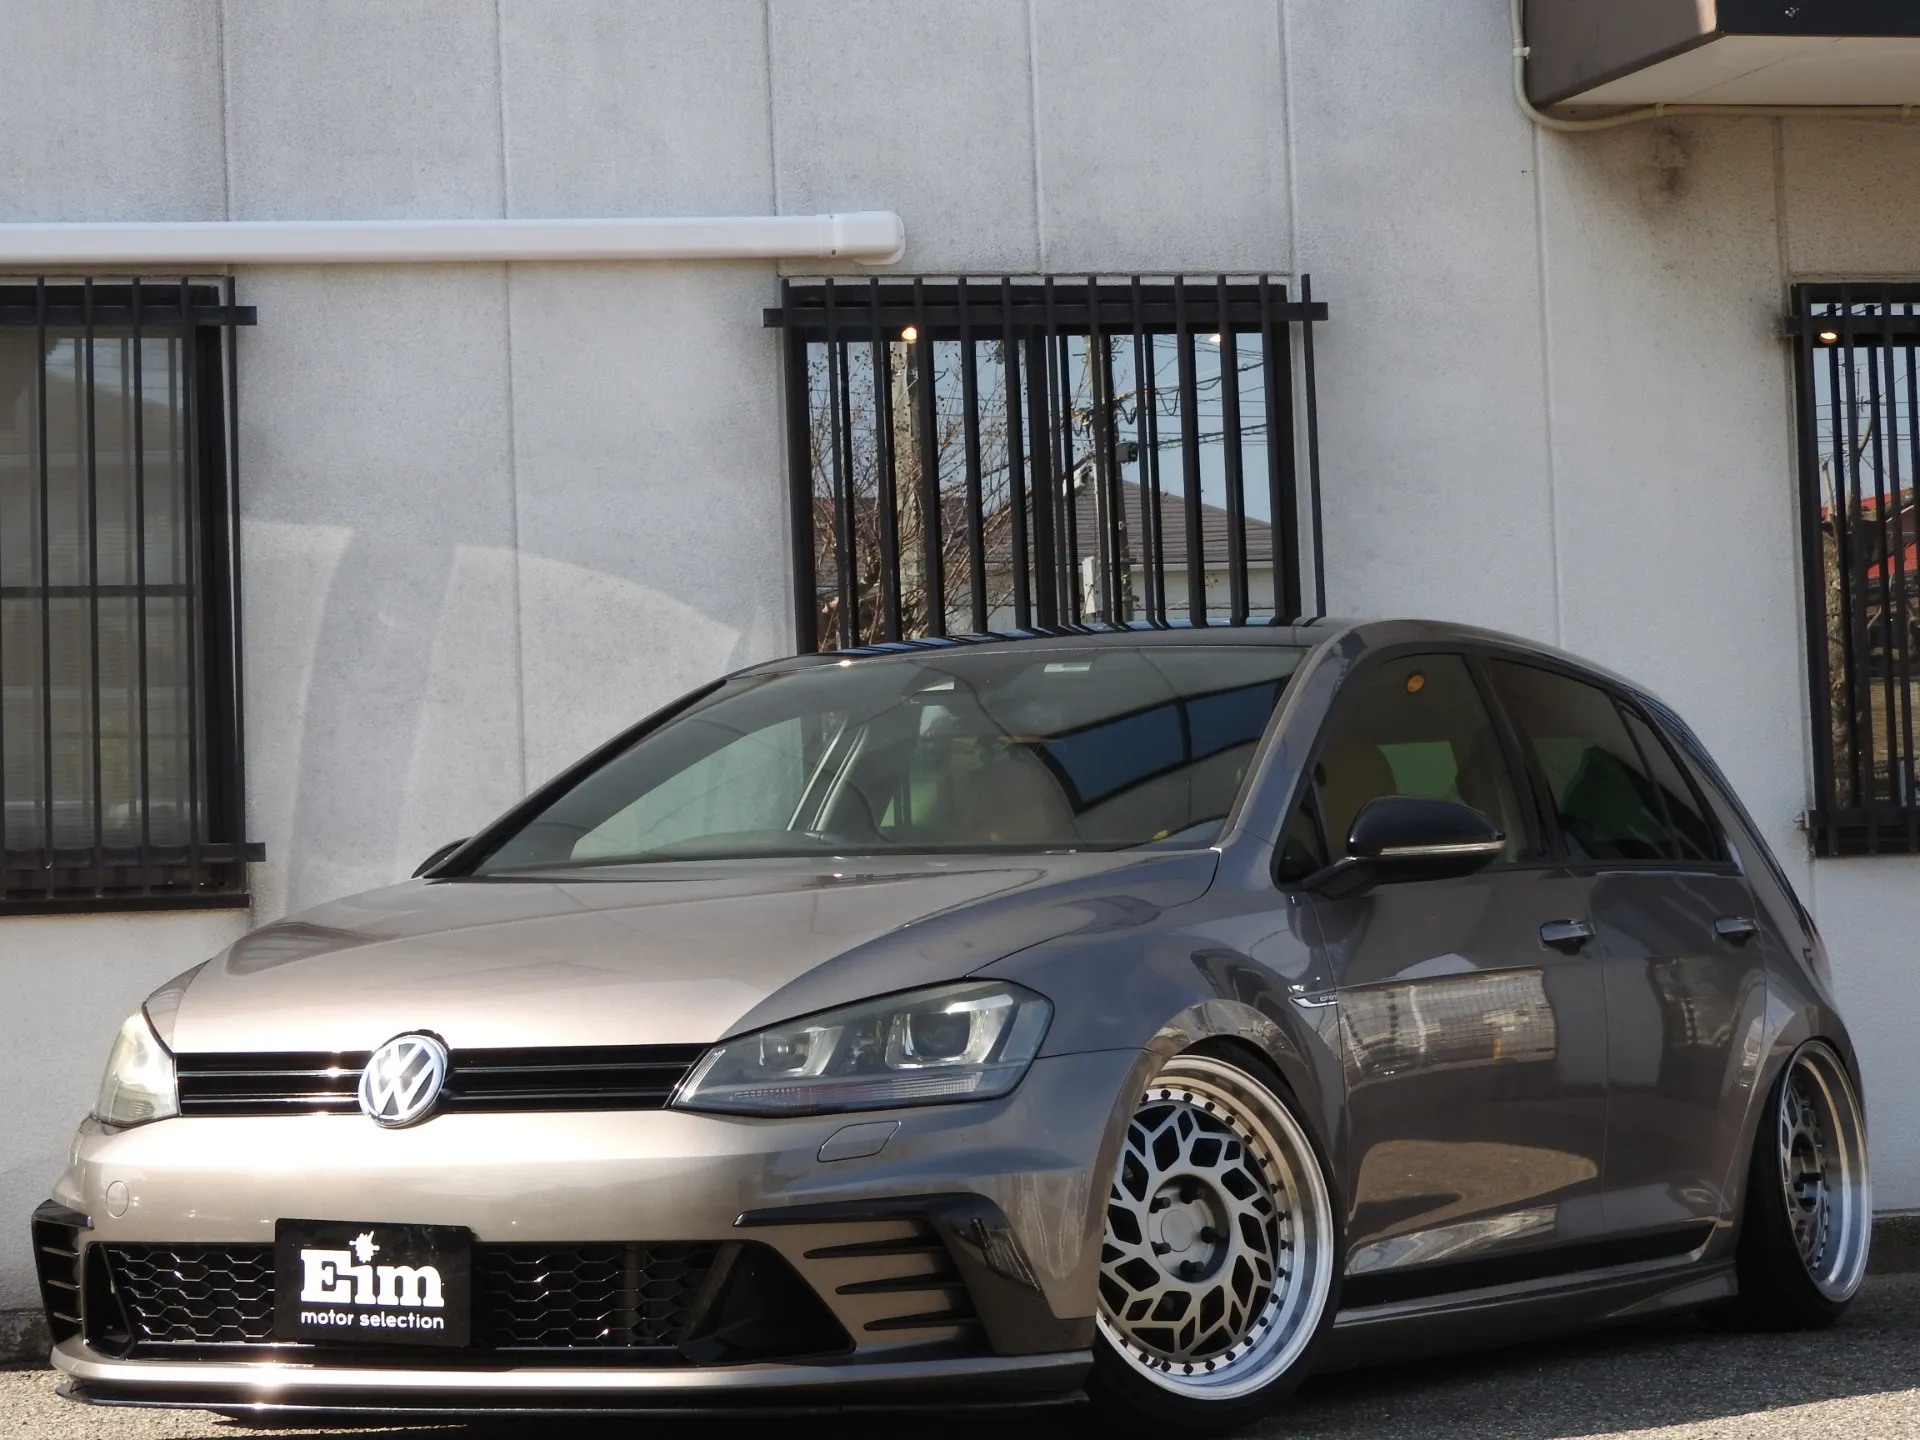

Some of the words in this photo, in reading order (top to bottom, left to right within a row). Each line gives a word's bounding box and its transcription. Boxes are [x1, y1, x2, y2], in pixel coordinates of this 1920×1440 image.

[361, 1036, 444, 1123] VW
[300, 1232, 445, 1308] Eim
[300, 1310, 355, 1326] motor
[359, 1311, 445, 1330] selection
